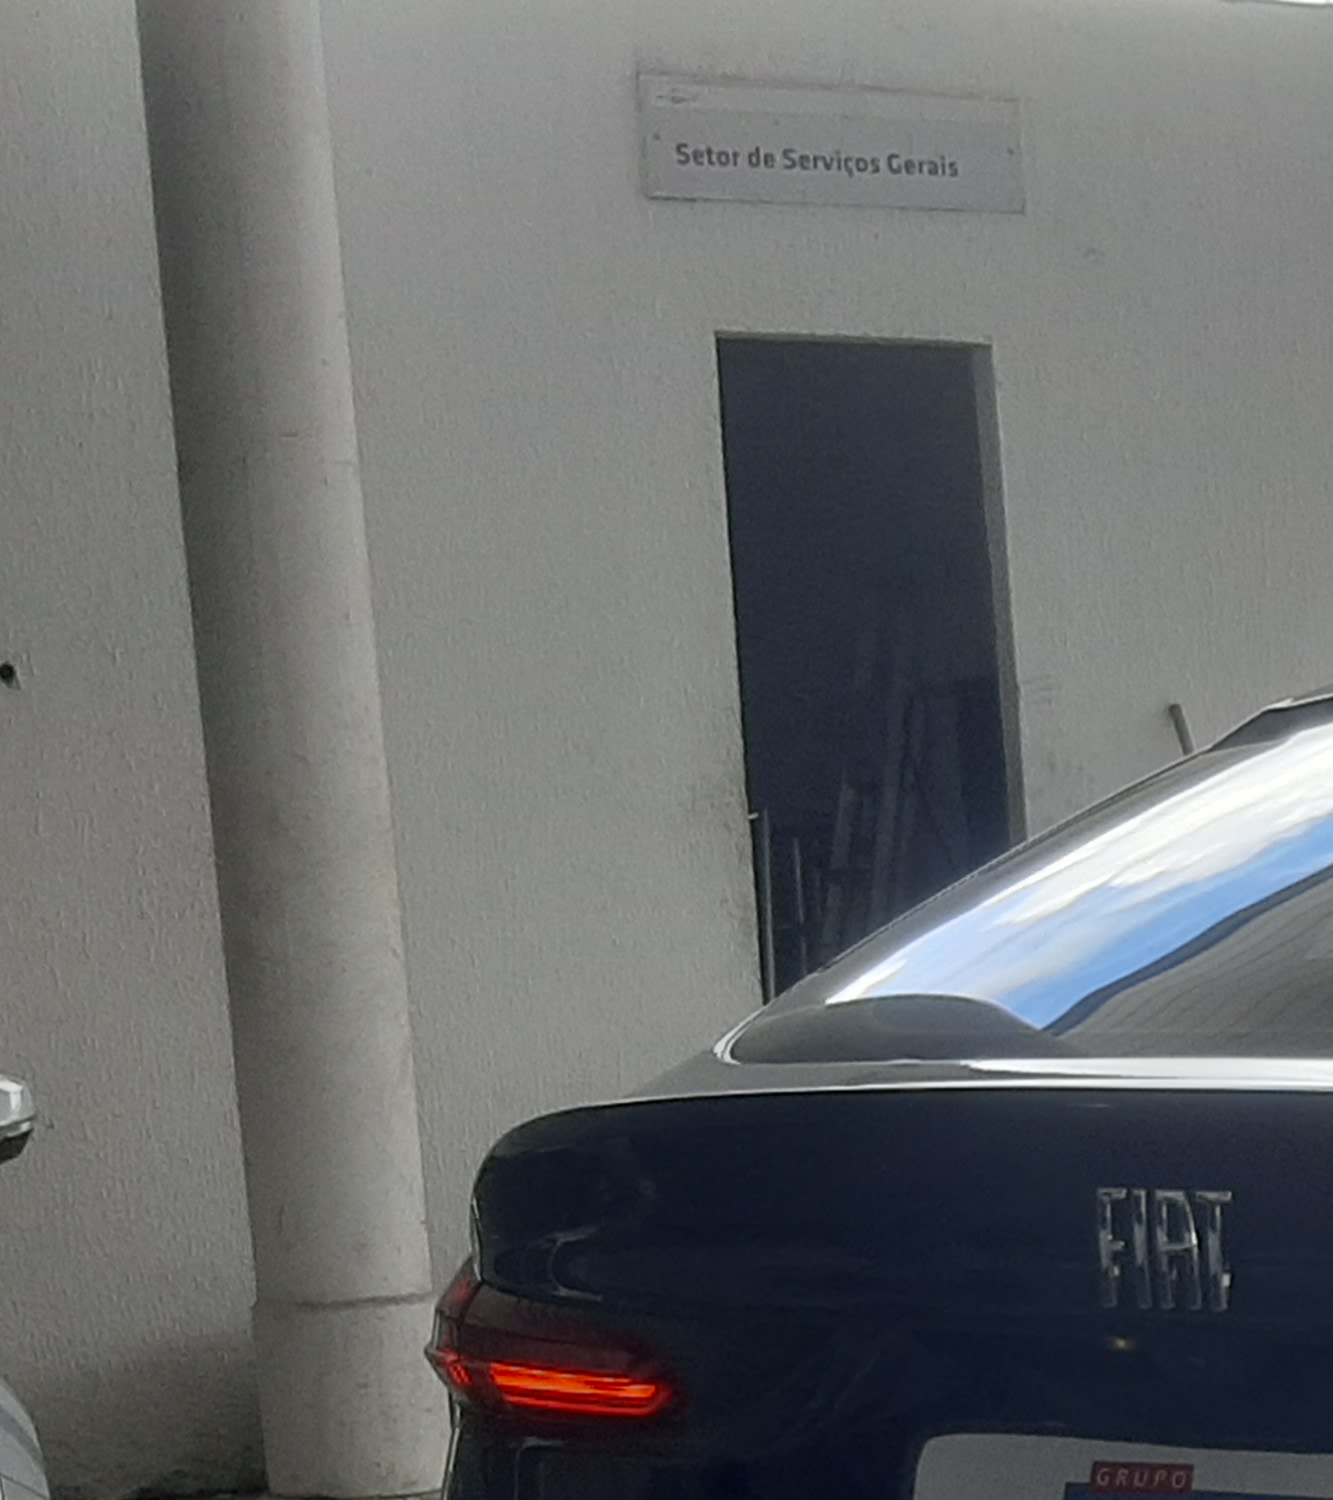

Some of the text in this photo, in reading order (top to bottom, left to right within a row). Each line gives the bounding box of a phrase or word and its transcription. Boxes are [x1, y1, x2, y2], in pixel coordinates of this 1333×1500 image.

[675, 142, 960, 178] Setor de Serviços Gerais
[1097, 1187, 1234, 1313] FIAT
[1096, 1467, 1189, 1489] GRUPO
